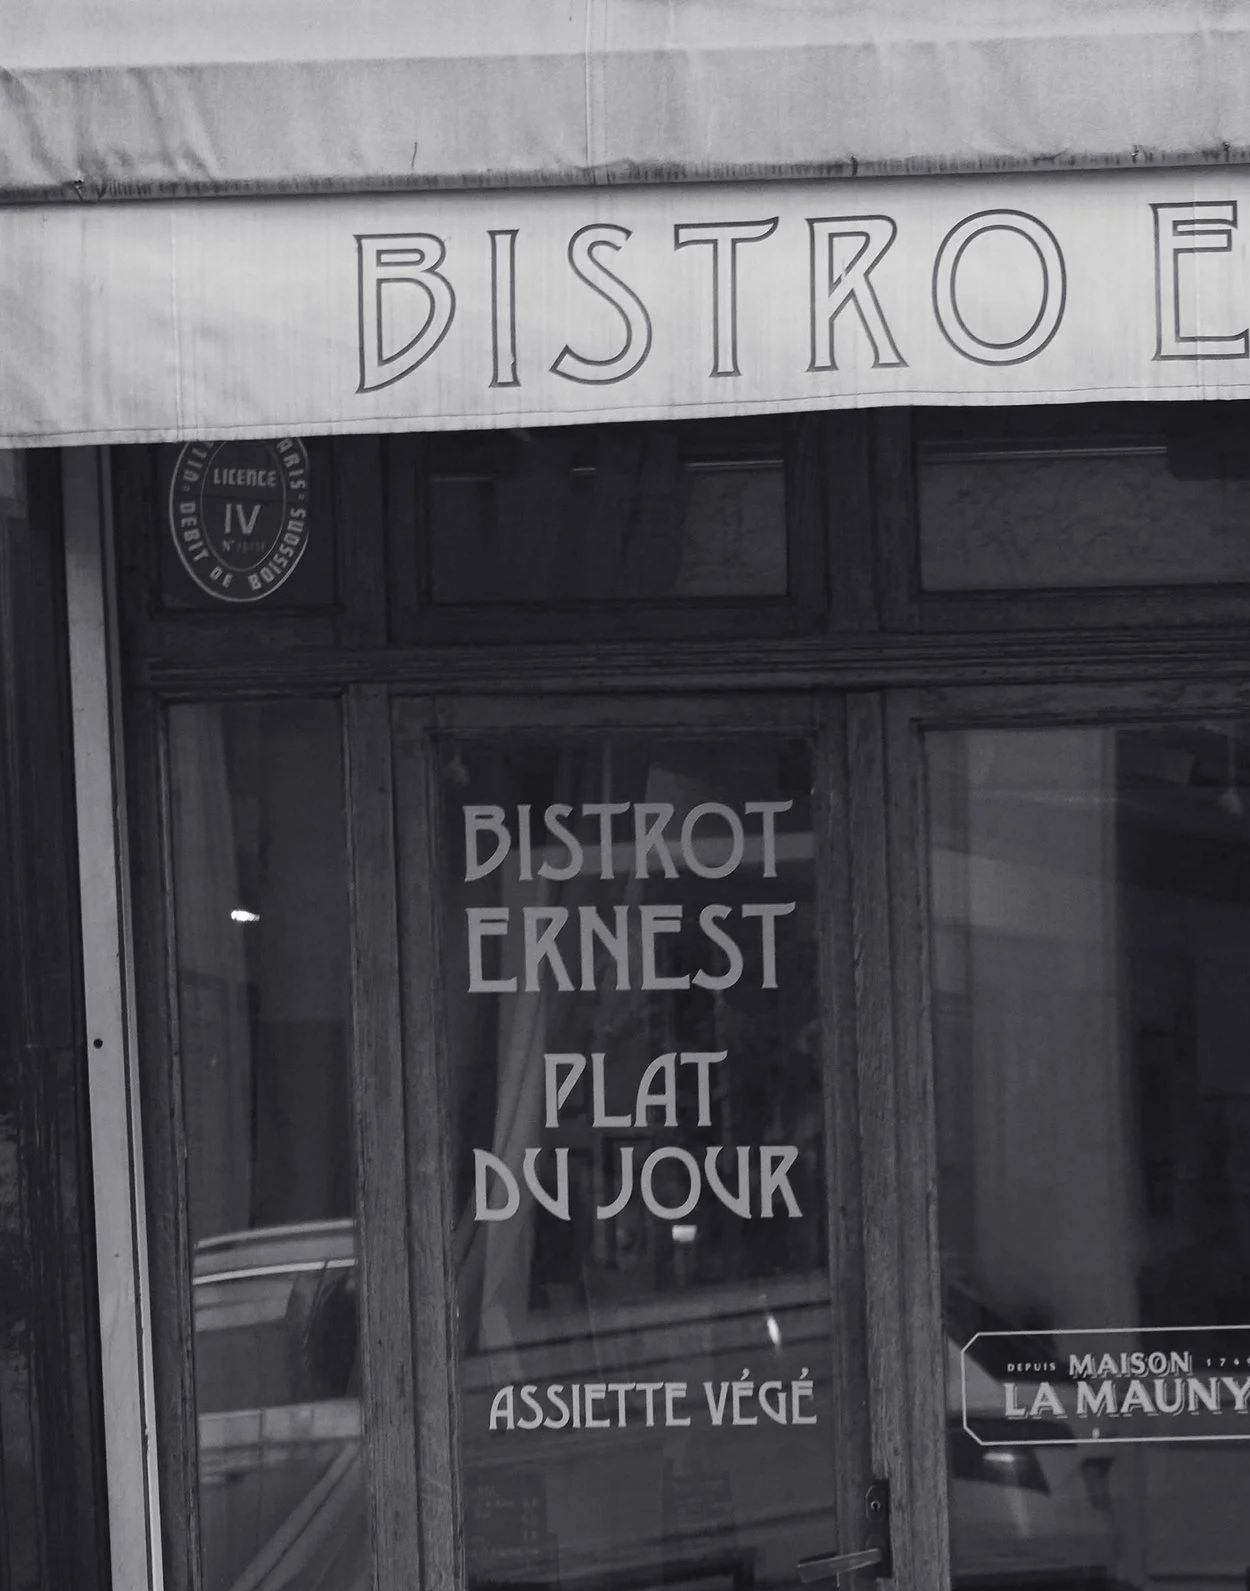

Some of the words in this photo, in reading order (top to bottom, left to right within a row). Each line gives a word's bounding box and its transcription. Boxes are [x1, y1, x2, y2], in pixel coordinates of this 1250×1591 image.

[354, 208, 1068, 394] BISTRO
[213, 468, 277, 487] LICENCE
[277, 438, 306, 489] ARIS
[209, 566, 234, 588] DE
[248, 508, 306, 591] BOISSONS
[223, 503, 261, 534] IV
[462, 800, 793, 882] BISTROT
[465, 901, 796, 993] ERNEST
[544, 1050, 728, 1129] PLAT
[473, 1147, 571, 1221] DU
[597, 1145, 803, 1220] JOUR
[489, 1381, 691, 1430] ASSIETTE
[703, 1367, 817, 1426] VÉGÉ
[1007, 1361, 1056, 1373] DEPUIS
[1069, 1350, 1193, 1379] MAISON
[1004, 1381, 1068, 1420] LA
